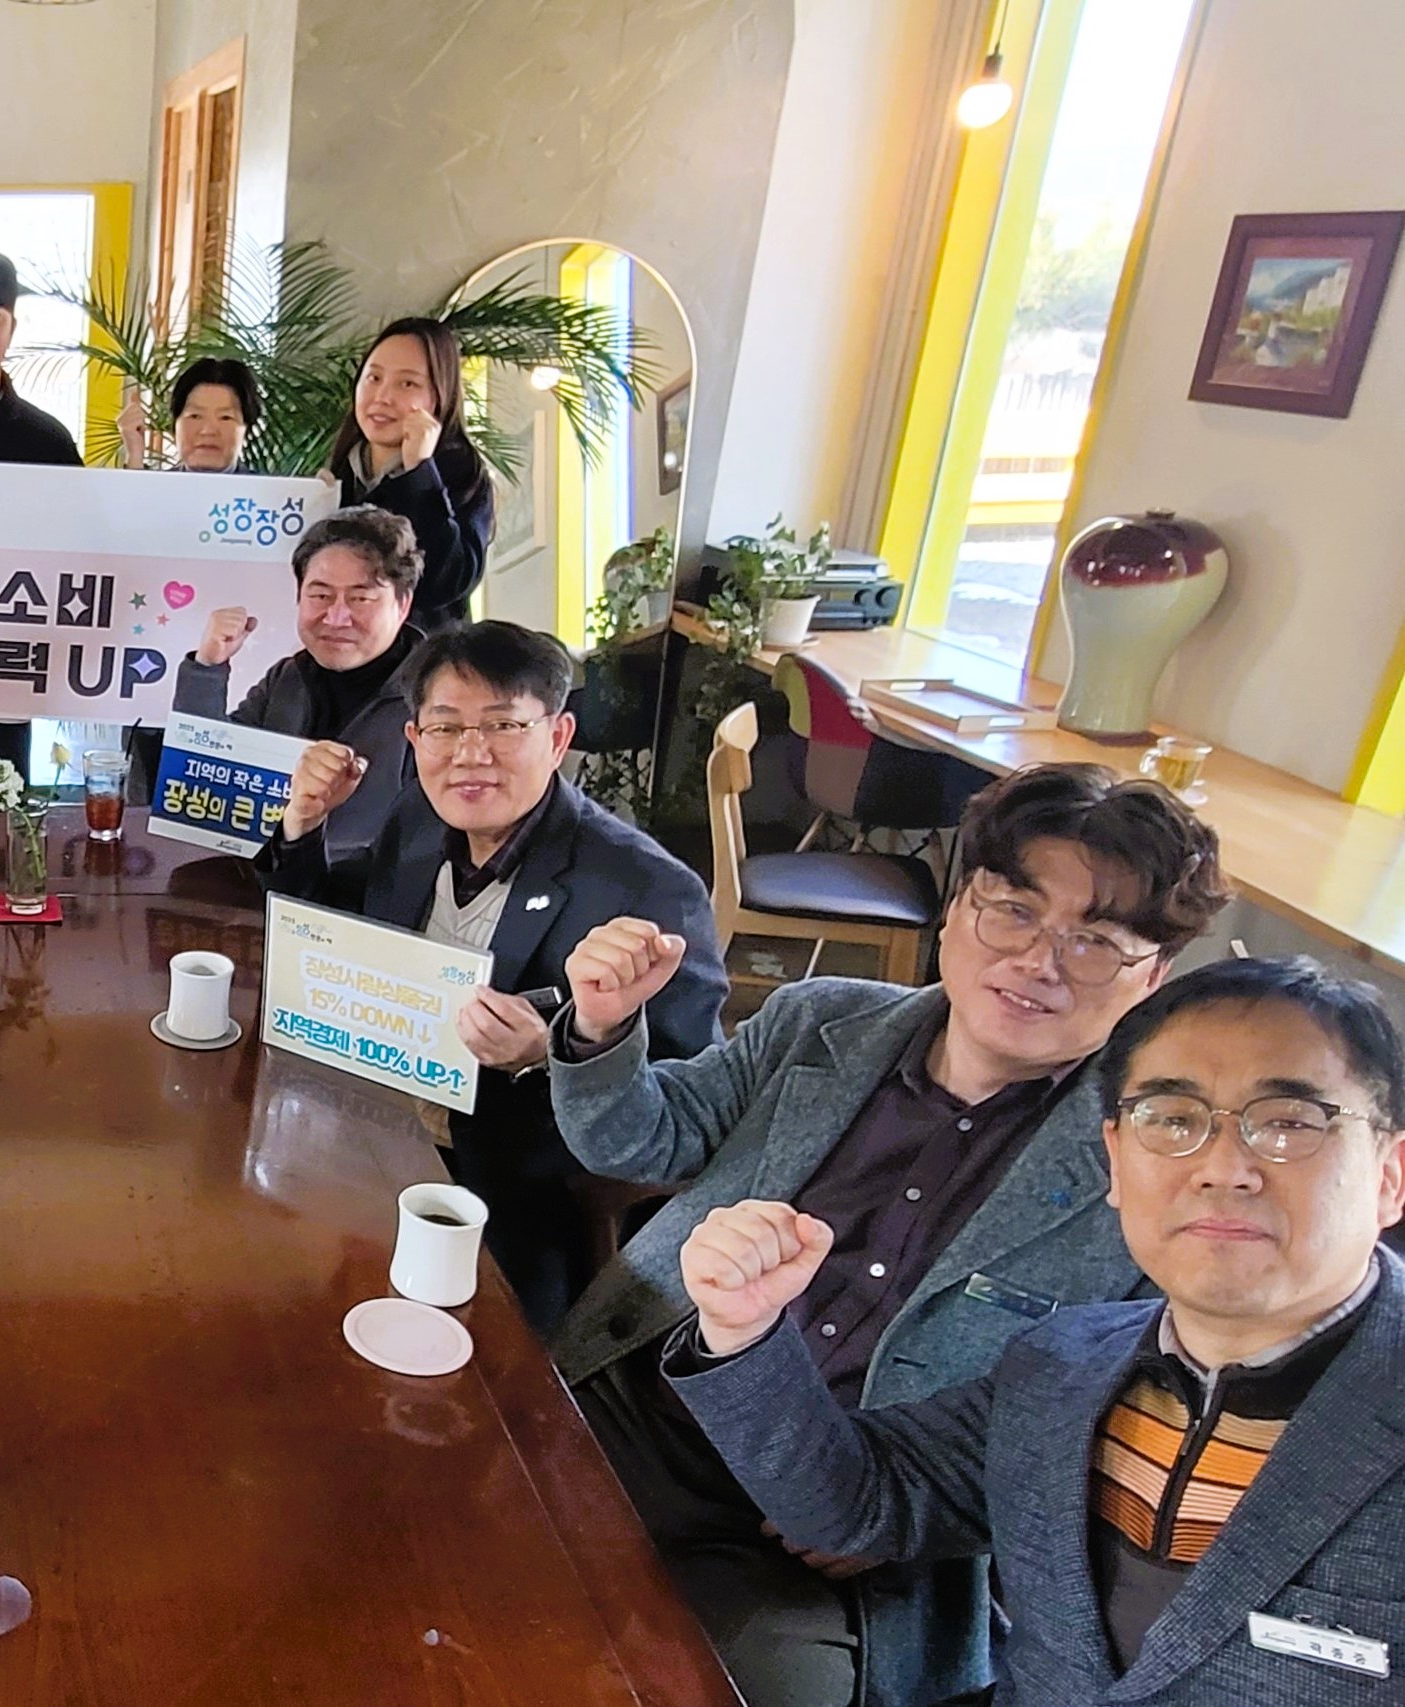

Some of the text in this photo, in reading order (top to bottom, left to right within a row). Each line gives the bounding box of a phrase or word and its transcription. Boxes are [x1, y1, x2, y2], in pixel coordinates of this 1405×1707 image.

[208, 497, 305, 546] 성장장성
[67, 644, 168, 699] UP
[185, 758, 231, 785] 지역의
[233, 770, 264, 794] 작은
[164, 778, 227, 823] 장성의
[231, 795, 255, 831] 큰
[309, 988, 414, 1039] 15% DOWN
[273, 1008, 447, 1080] 지역경제 100% UP
